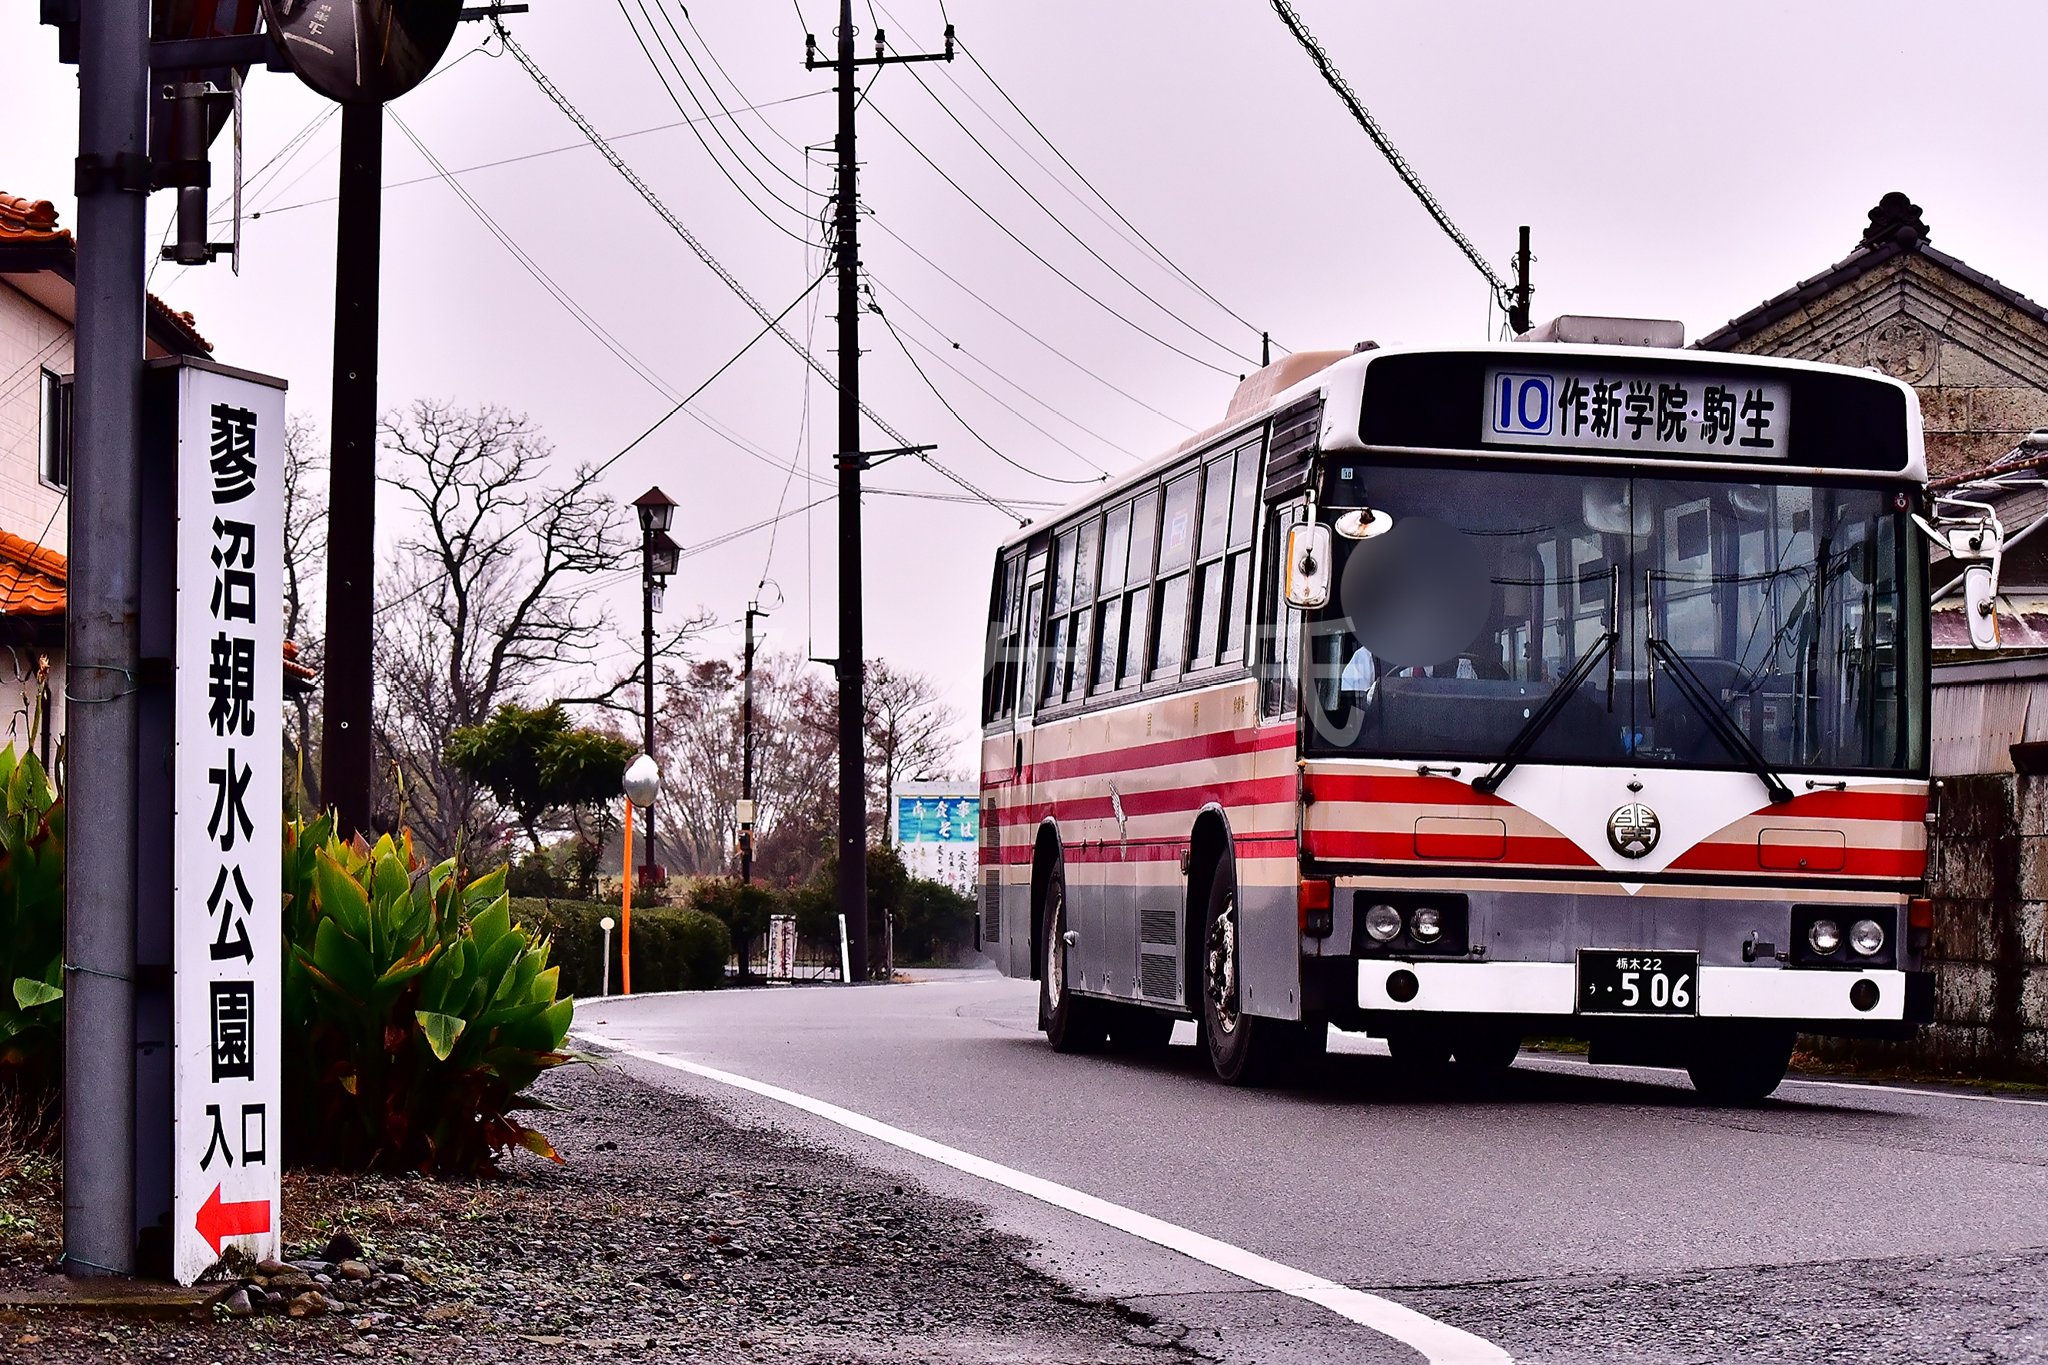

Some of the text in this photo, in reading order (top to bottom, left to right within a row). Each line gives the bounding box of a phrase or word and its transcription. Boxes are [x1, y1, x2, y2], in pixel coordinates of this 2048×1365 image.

[1501, 377, 1549, 430] 10
[206, 402, 258, 1084] 蓼沼親水公園
[200, 1102, 266, 1172] 入口
